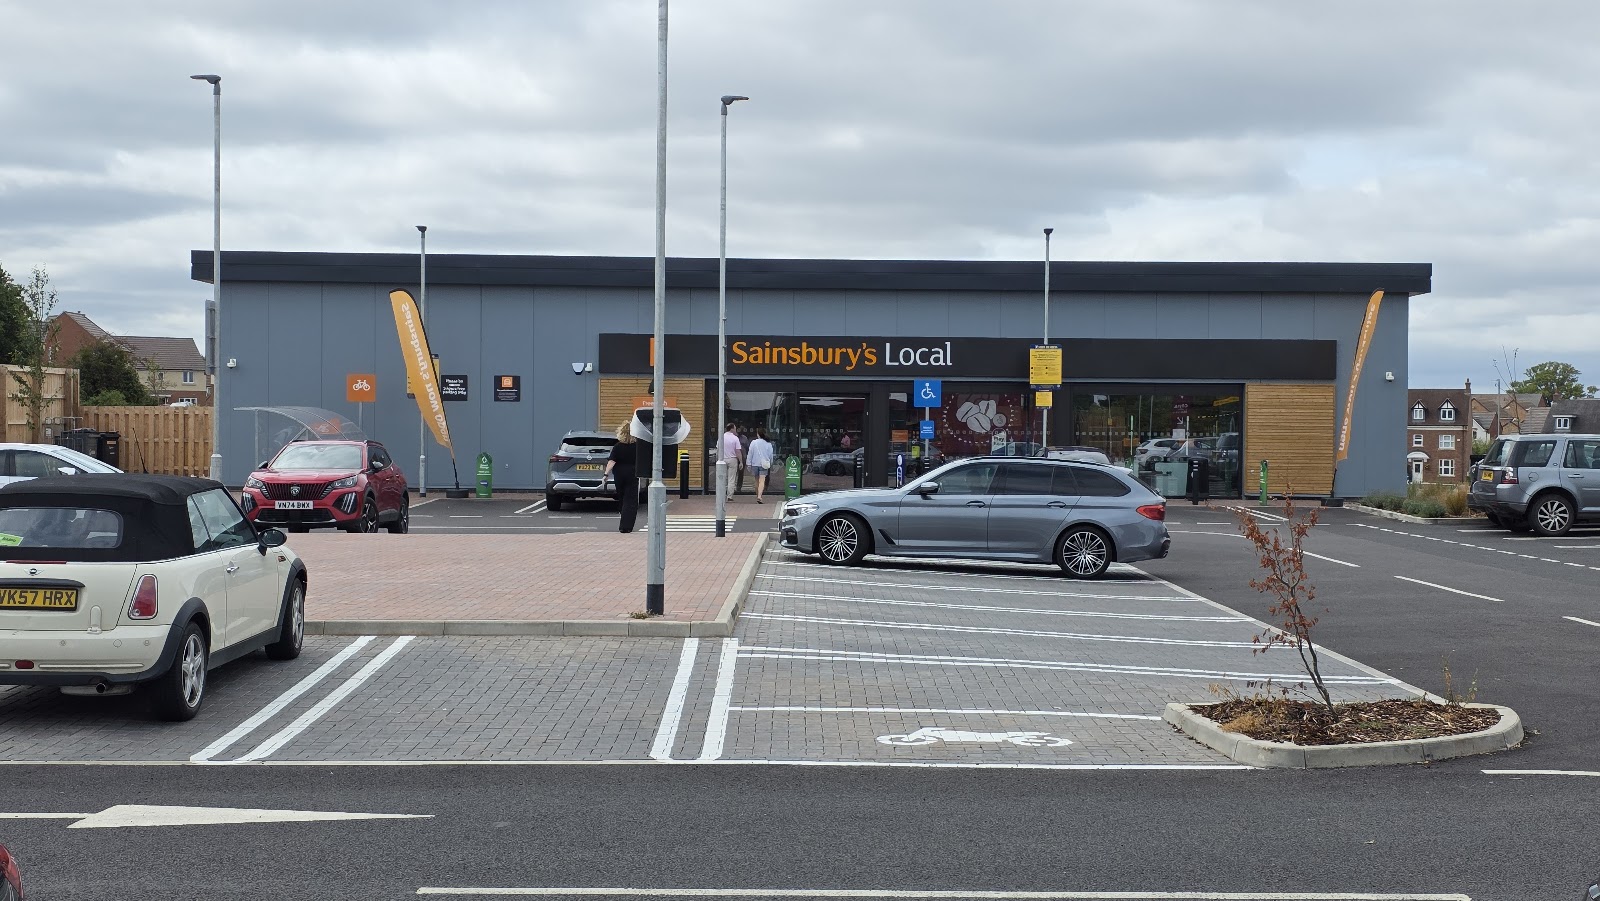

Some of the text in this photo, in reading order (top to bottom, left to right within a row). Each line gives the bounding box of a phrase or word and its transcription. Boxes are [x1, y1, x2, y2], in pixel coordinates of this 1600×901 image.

[732, 341, 953, 371] Sainsbury's Local
[277, 501, 295, 509] VN74
[43, 590, 75, 606] HRX
